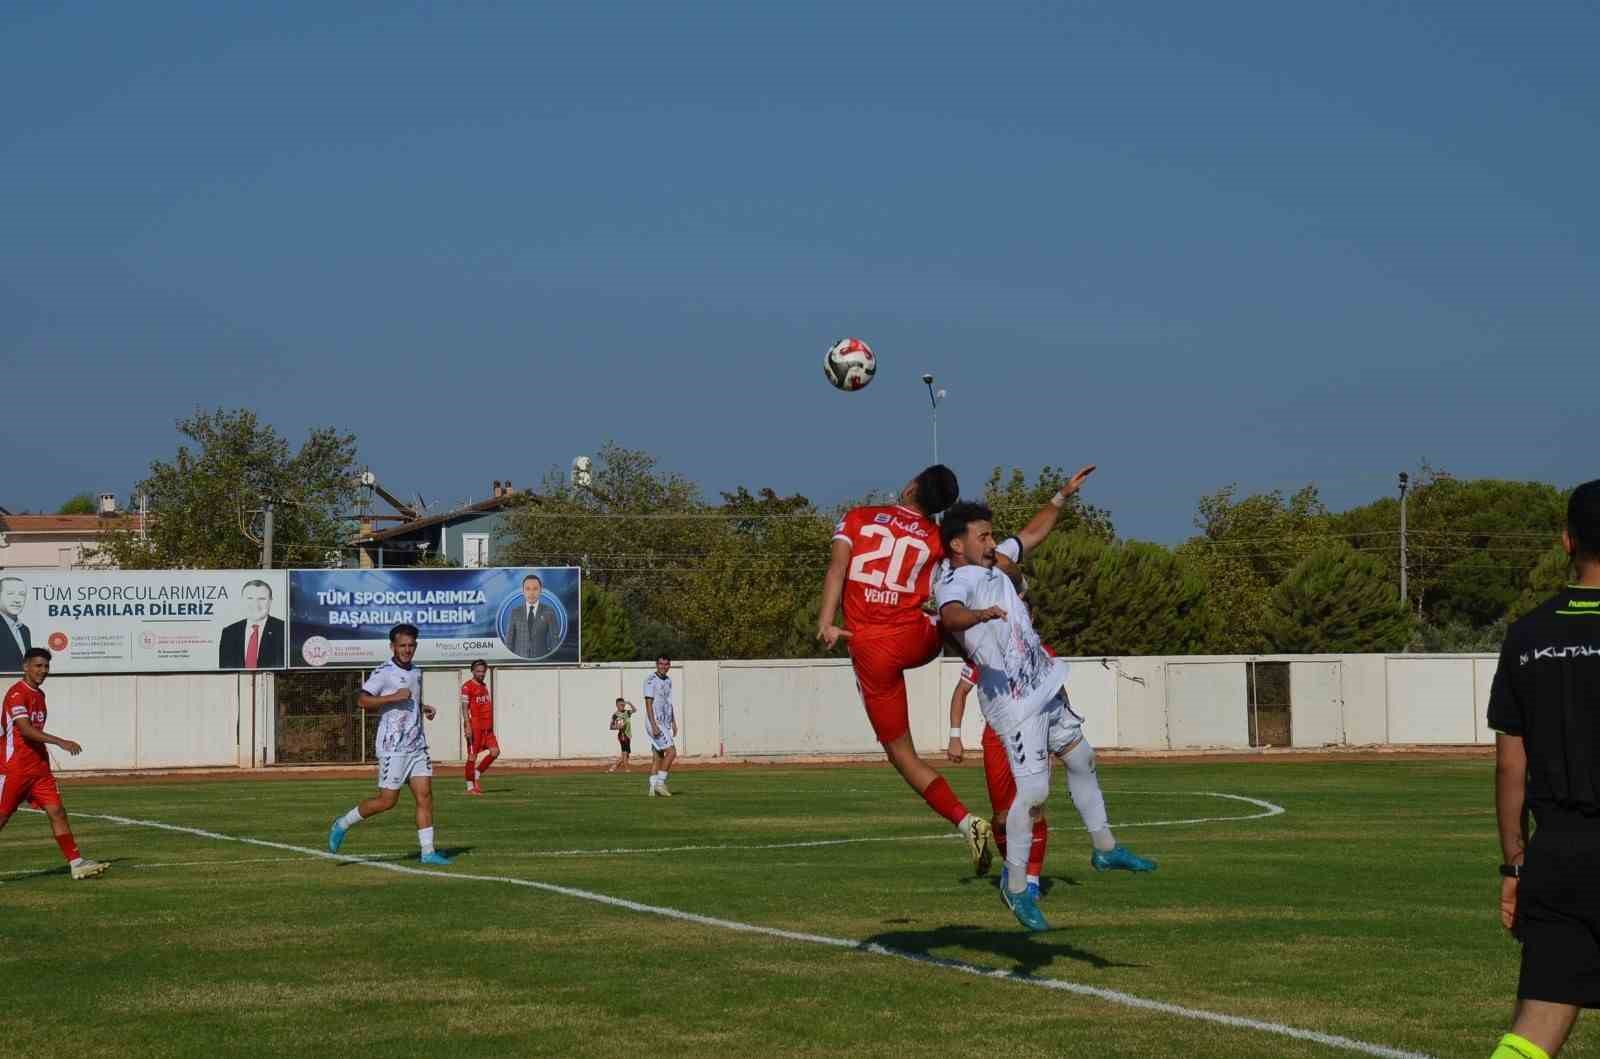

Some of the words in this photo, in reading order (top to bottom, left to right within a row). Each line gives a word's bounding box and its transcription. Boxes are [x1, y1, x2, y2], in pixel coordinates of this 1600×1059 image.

[849, 524, 930, 593] 20
[32, 584, 72, 601] TÜM
[77, 585, 229, 601] SPORCULARIMIZA
[317, 589, 351, 605] TÜM
[353, 590, 487, 605] SPORCULARIMIZA
[48, 603, 145, 620] BAŞARILAR
[150, 600, 214, 616] DİLERİZ
[328, 610, 413, 628] BAŞARILAR
[417, 606, 476, 624] DİLERİM
[463, 640, 494, 651] ÇOBAN
[1534, 644, 1600, 659] KUTAH
